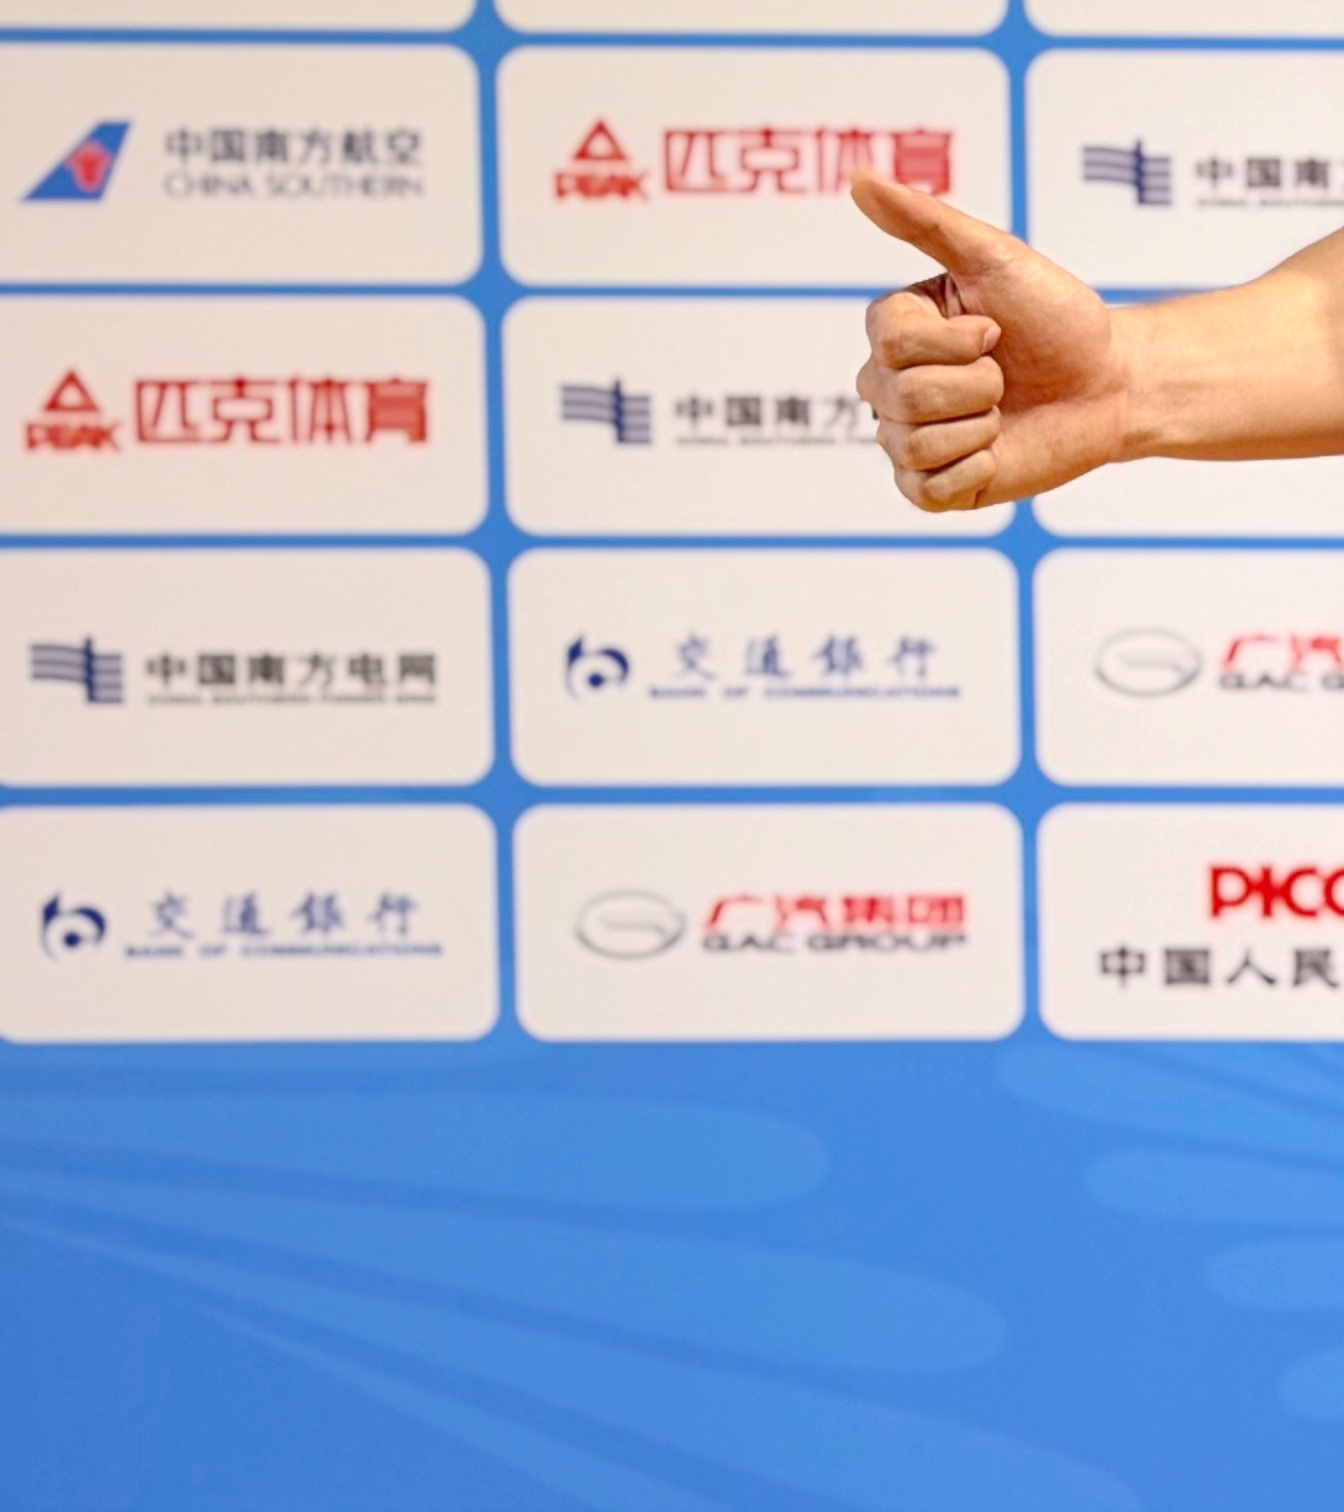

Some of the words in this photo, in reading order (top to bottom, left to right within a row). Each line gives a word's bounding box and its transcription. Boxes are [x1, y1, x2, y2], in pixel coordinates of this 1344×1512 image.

[164, 129, 420, 164] 中国南方航空
[136, 378, 428, 444] 匹克体育
[675, 394, 880, 431] 中国南方
[1219, 672, 1308, 690] GAC
[702, 933, 793, 952] GAC
[808, 932, 965, 951] GROUP
